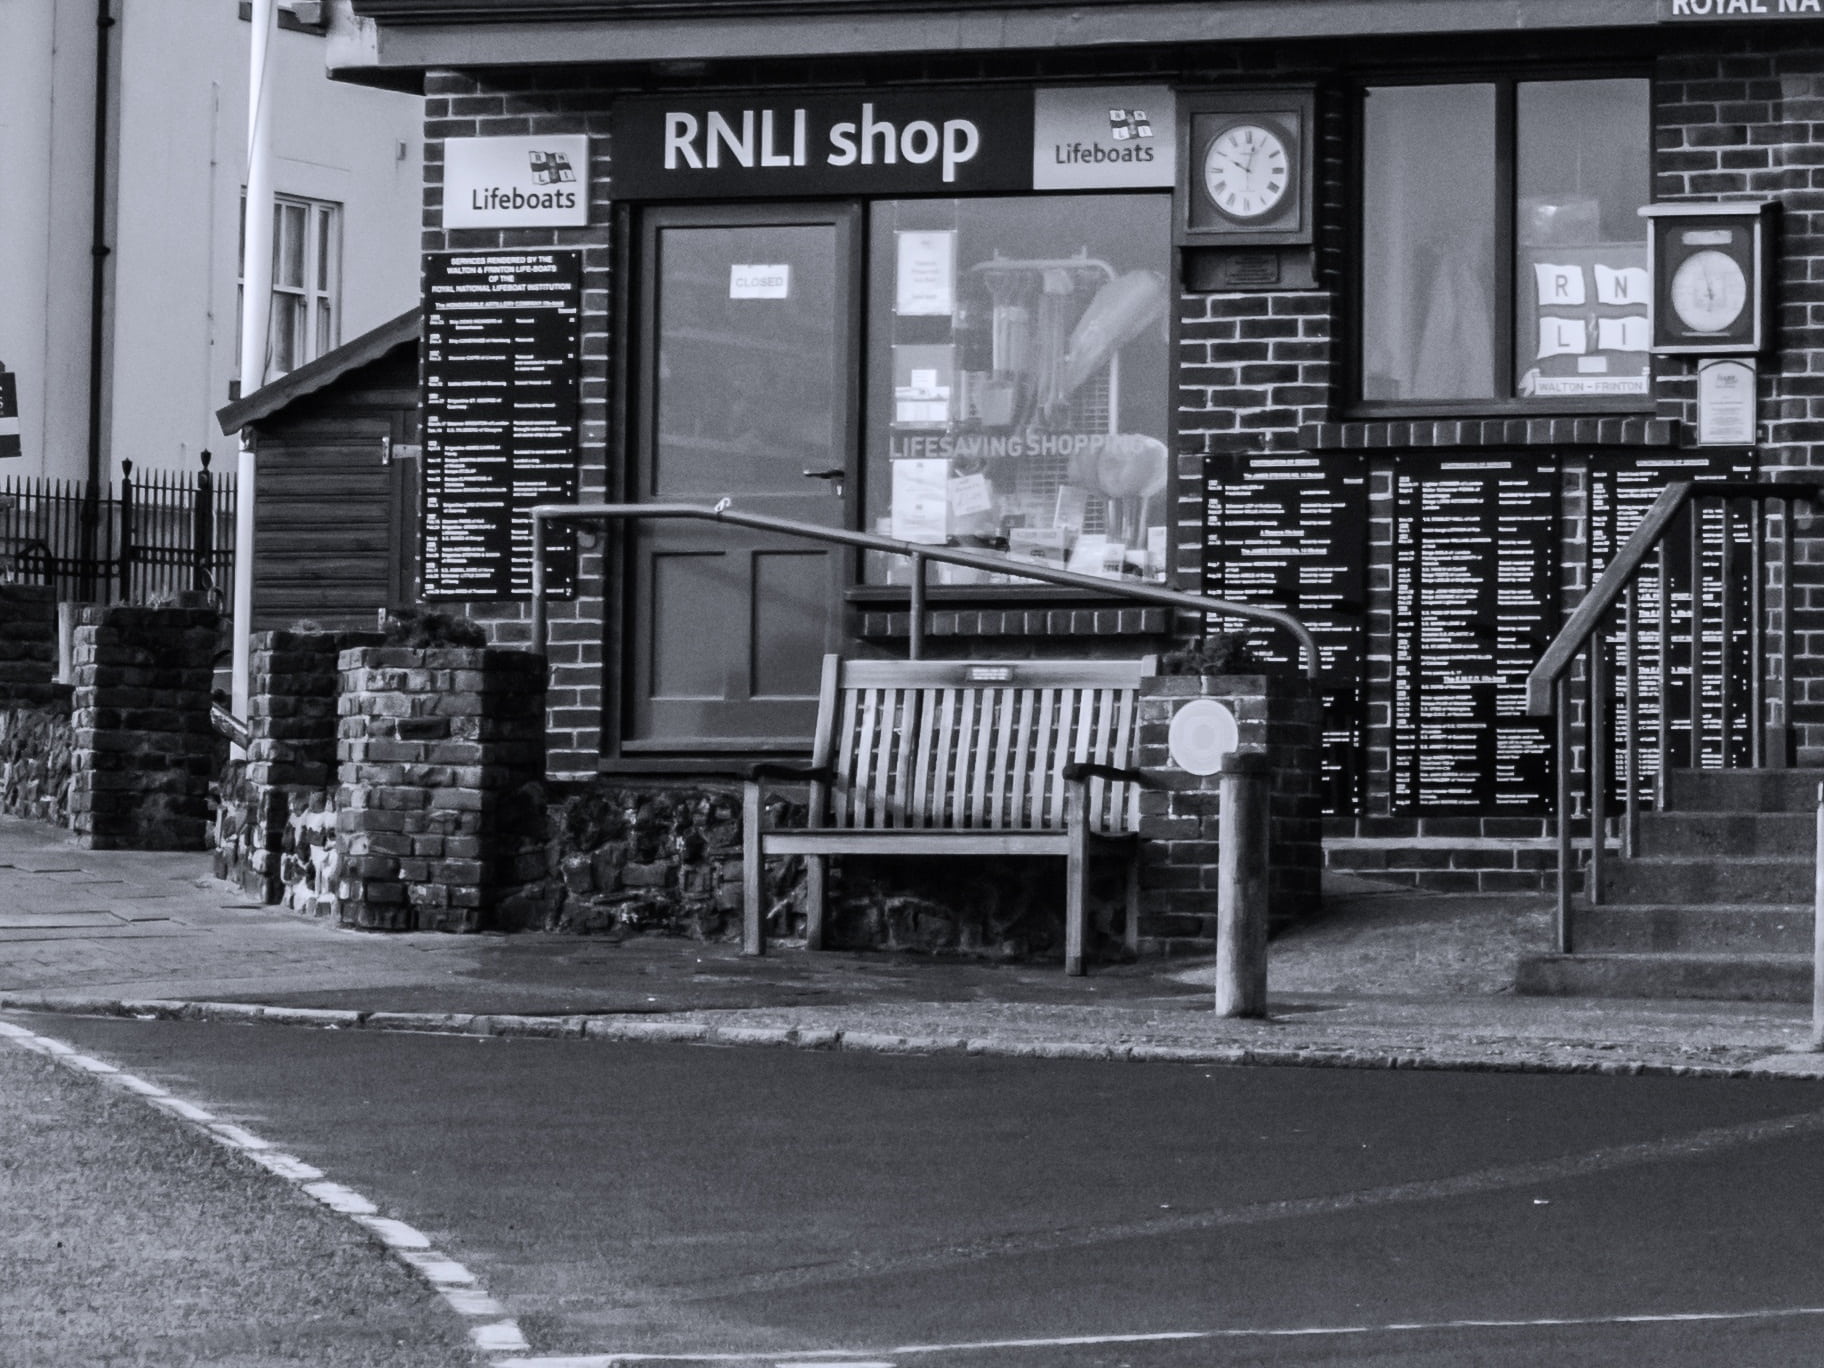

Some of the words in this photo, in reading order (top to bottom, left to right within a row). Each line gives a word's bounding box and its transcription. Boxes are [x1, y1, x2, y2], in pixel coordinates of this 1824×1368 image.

[665, 109, 805, 168] RNLI
[827, 103, 979, 182] shop
[1056, 142, 1154, 164] Lifeboats
[472, 187, 576, 211] Lifeboats
[447, 266, 476, 275] WALTON
[488, 275, 499, 283] OF
[736, 276, 783, 288] CLOSED
[1555, 275, 1568, 296] R
[1615, 275, 1627, 298] N
[1558, 324, 1570, 347] L
[1539, 382, 1584, 392] WALTON
[1594, 382, 1643, 392] FRINTON
[889, 435, 1022, 458] LIFESAVING
[1026, 433, 1146, 457] SHOPPING
